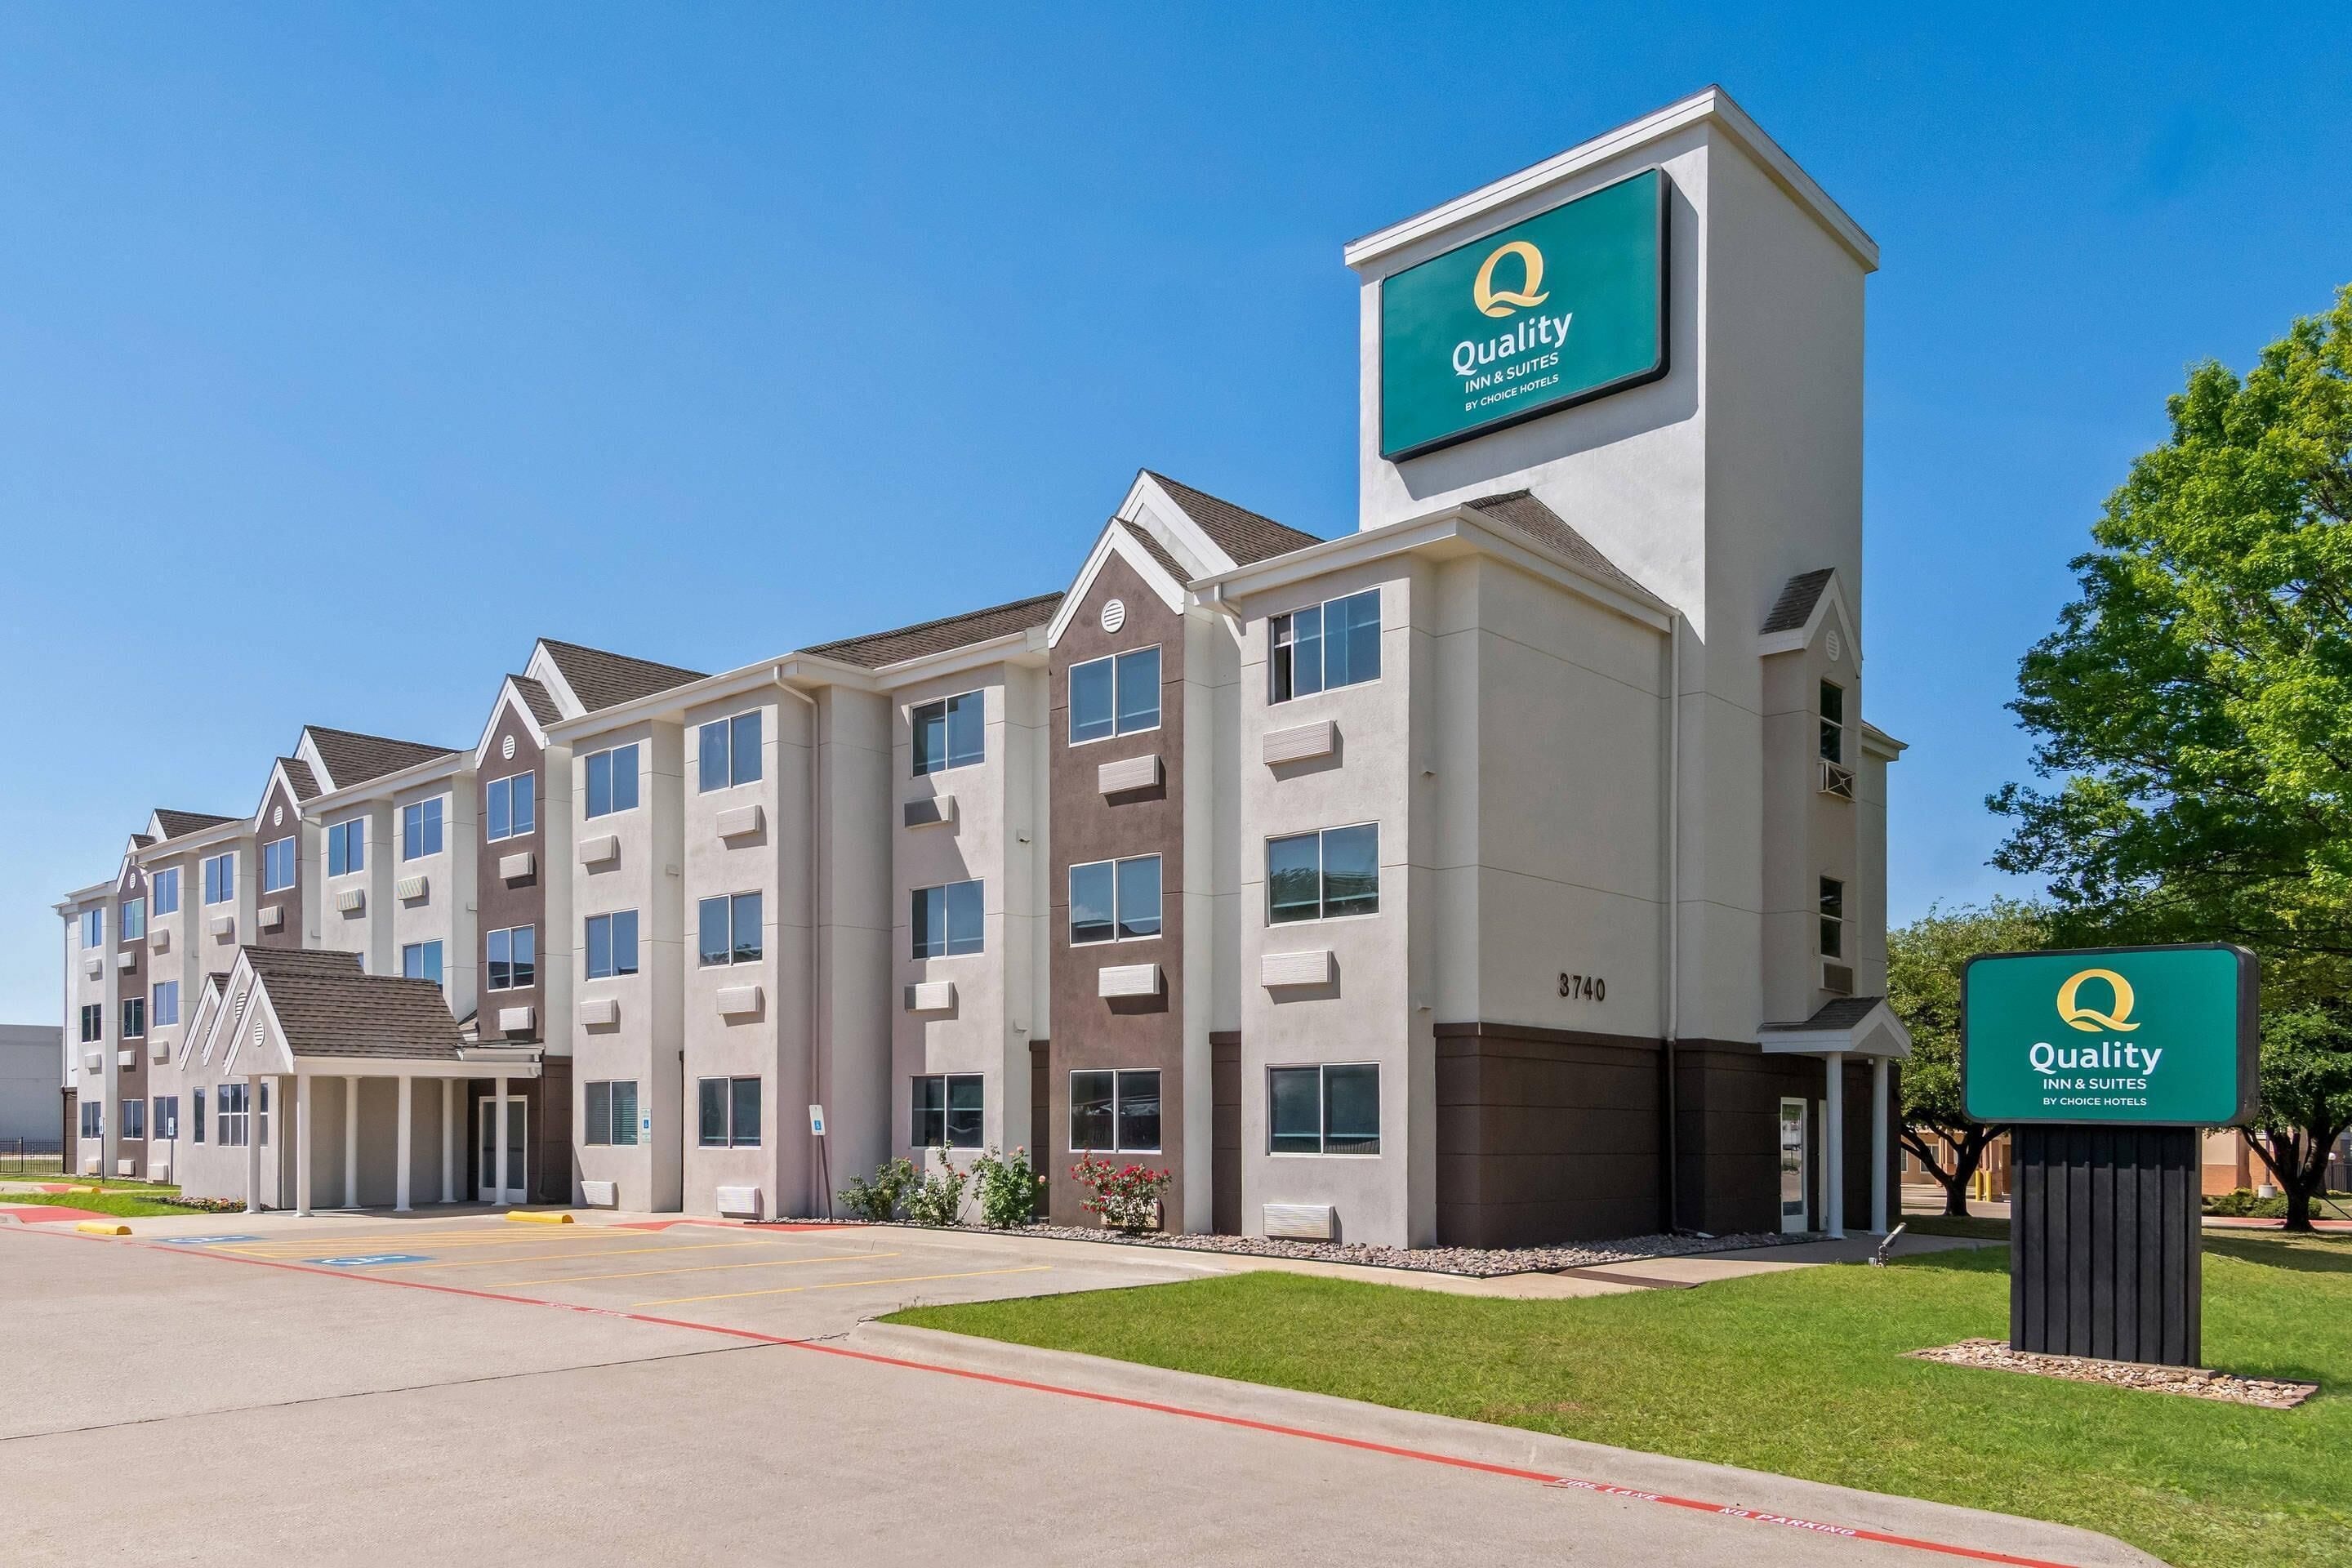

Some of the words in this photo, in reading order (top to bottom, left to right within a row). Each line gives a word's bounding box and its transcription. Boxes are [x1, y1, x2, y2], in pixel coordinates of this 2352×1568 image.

[1473, 241, 1550, 318] Q
[1452, 313, 1573, 376] Quality
[1465, 374, 1490, 394] INN
[1494, 370, 1503, 384] &
[1507, 352, 1558, 380] SUITES
[1465, 400, 1478, 412] BY
[1480, 387, 1517, 406] CHOICE
[1520, 374, 1559, 394] HOTELS
[1557, 973, 1606, 1001] 3740
[2056, 969, 2141, 1032] Q
[2029, 1041, 2163, 1075] Quality
[2043, 1078, 2071, 1089] INN
[2074, 1078, 2086, 1089] &
[2089, 1078, 2147, 1089] SUITES
[2104, 1098, 2147, 1106] HOTELS
[1555, 1478, 1601, 1490] FIRE
[1606, 1487, 1664, 1500] LANE
[1718, 1508, 1749, 1517] NO
[1756, 1514, 1856, 1535] PARKING
